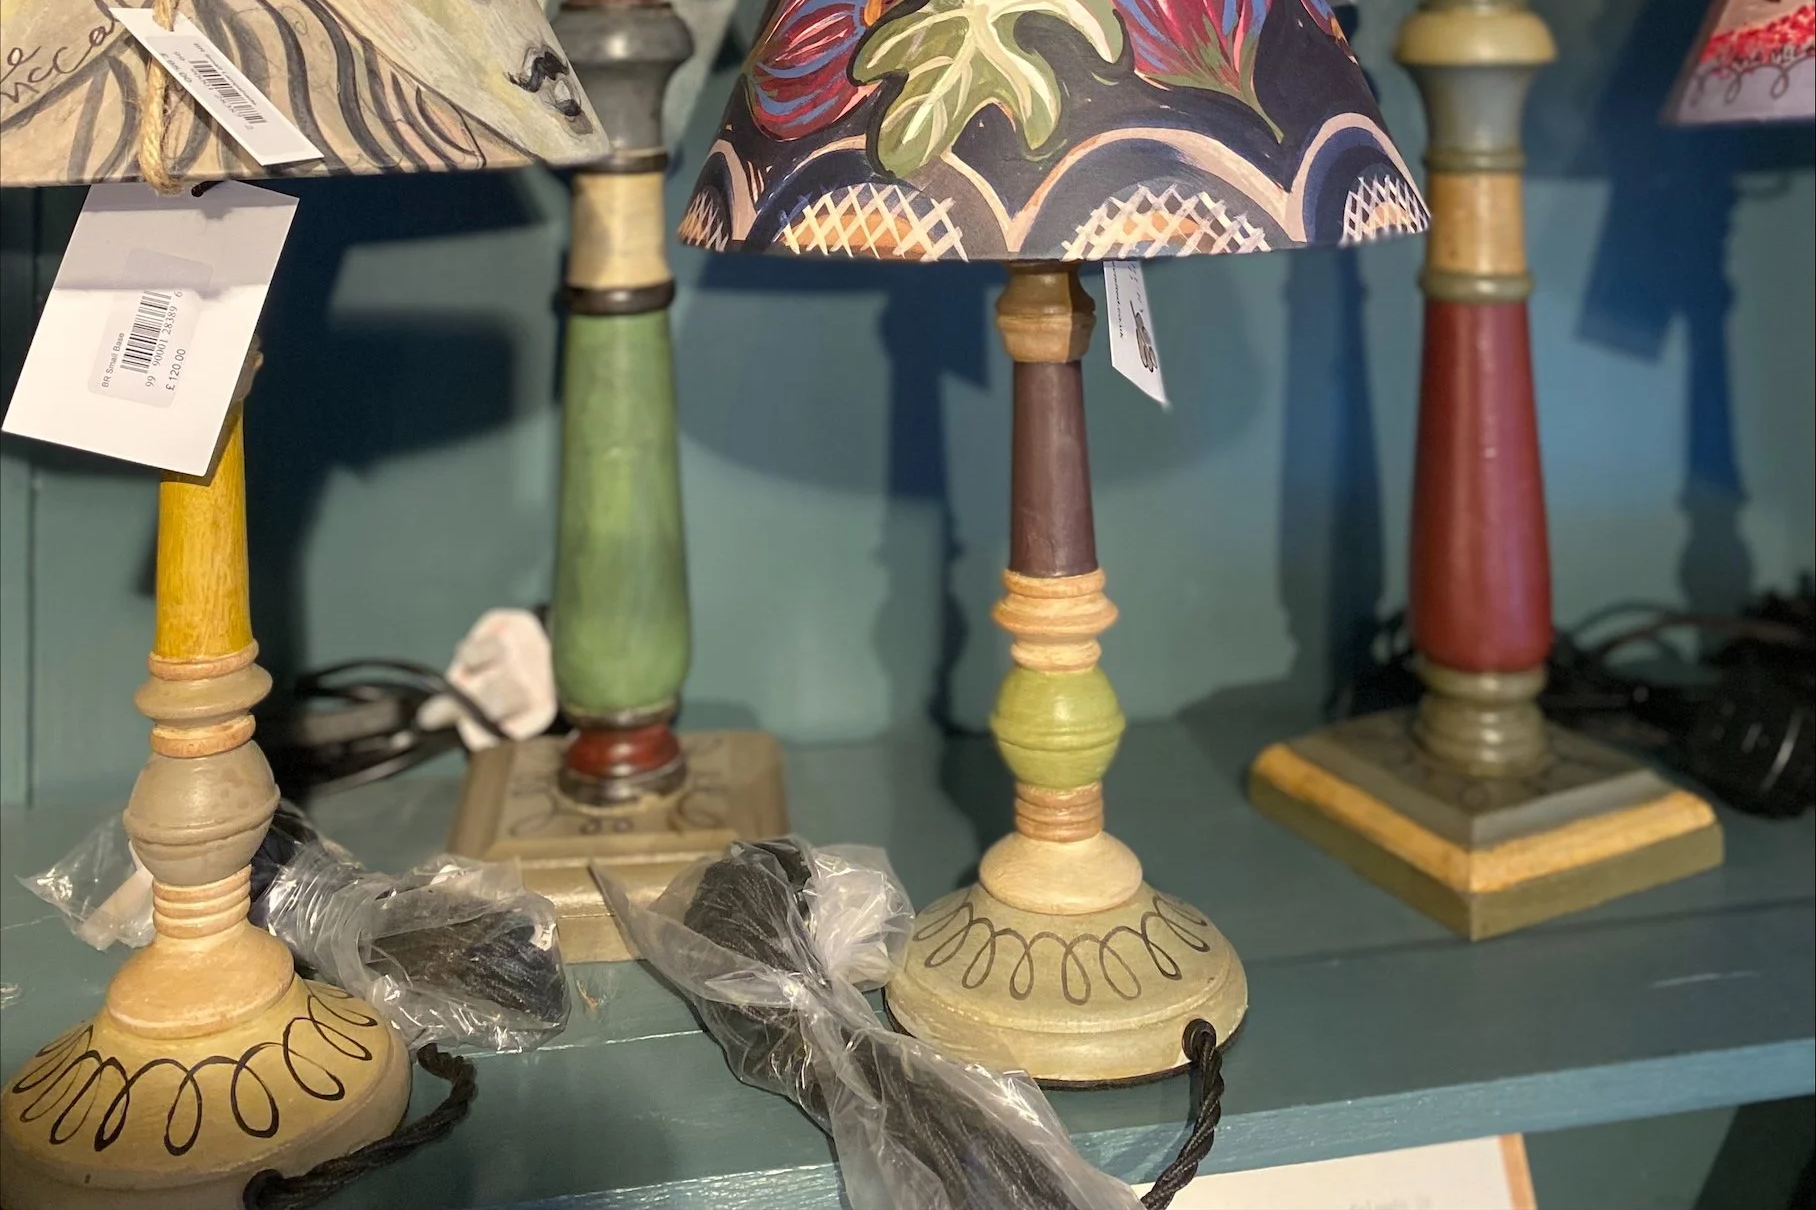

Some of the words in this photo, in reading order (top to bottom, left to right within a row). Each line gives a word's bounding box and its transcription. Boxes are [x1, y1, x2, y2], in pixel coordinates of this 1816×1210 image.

[113, 332, 125, 351] Base
[145, 375, 156, 387] 99
[152, 338, 168, 366] 90001
[161, 305, 178, 335] 28389
[173, 289, 183, 298] 6
[106, 353, 118, 374] Small
[101, 375, 112, 388] BR
